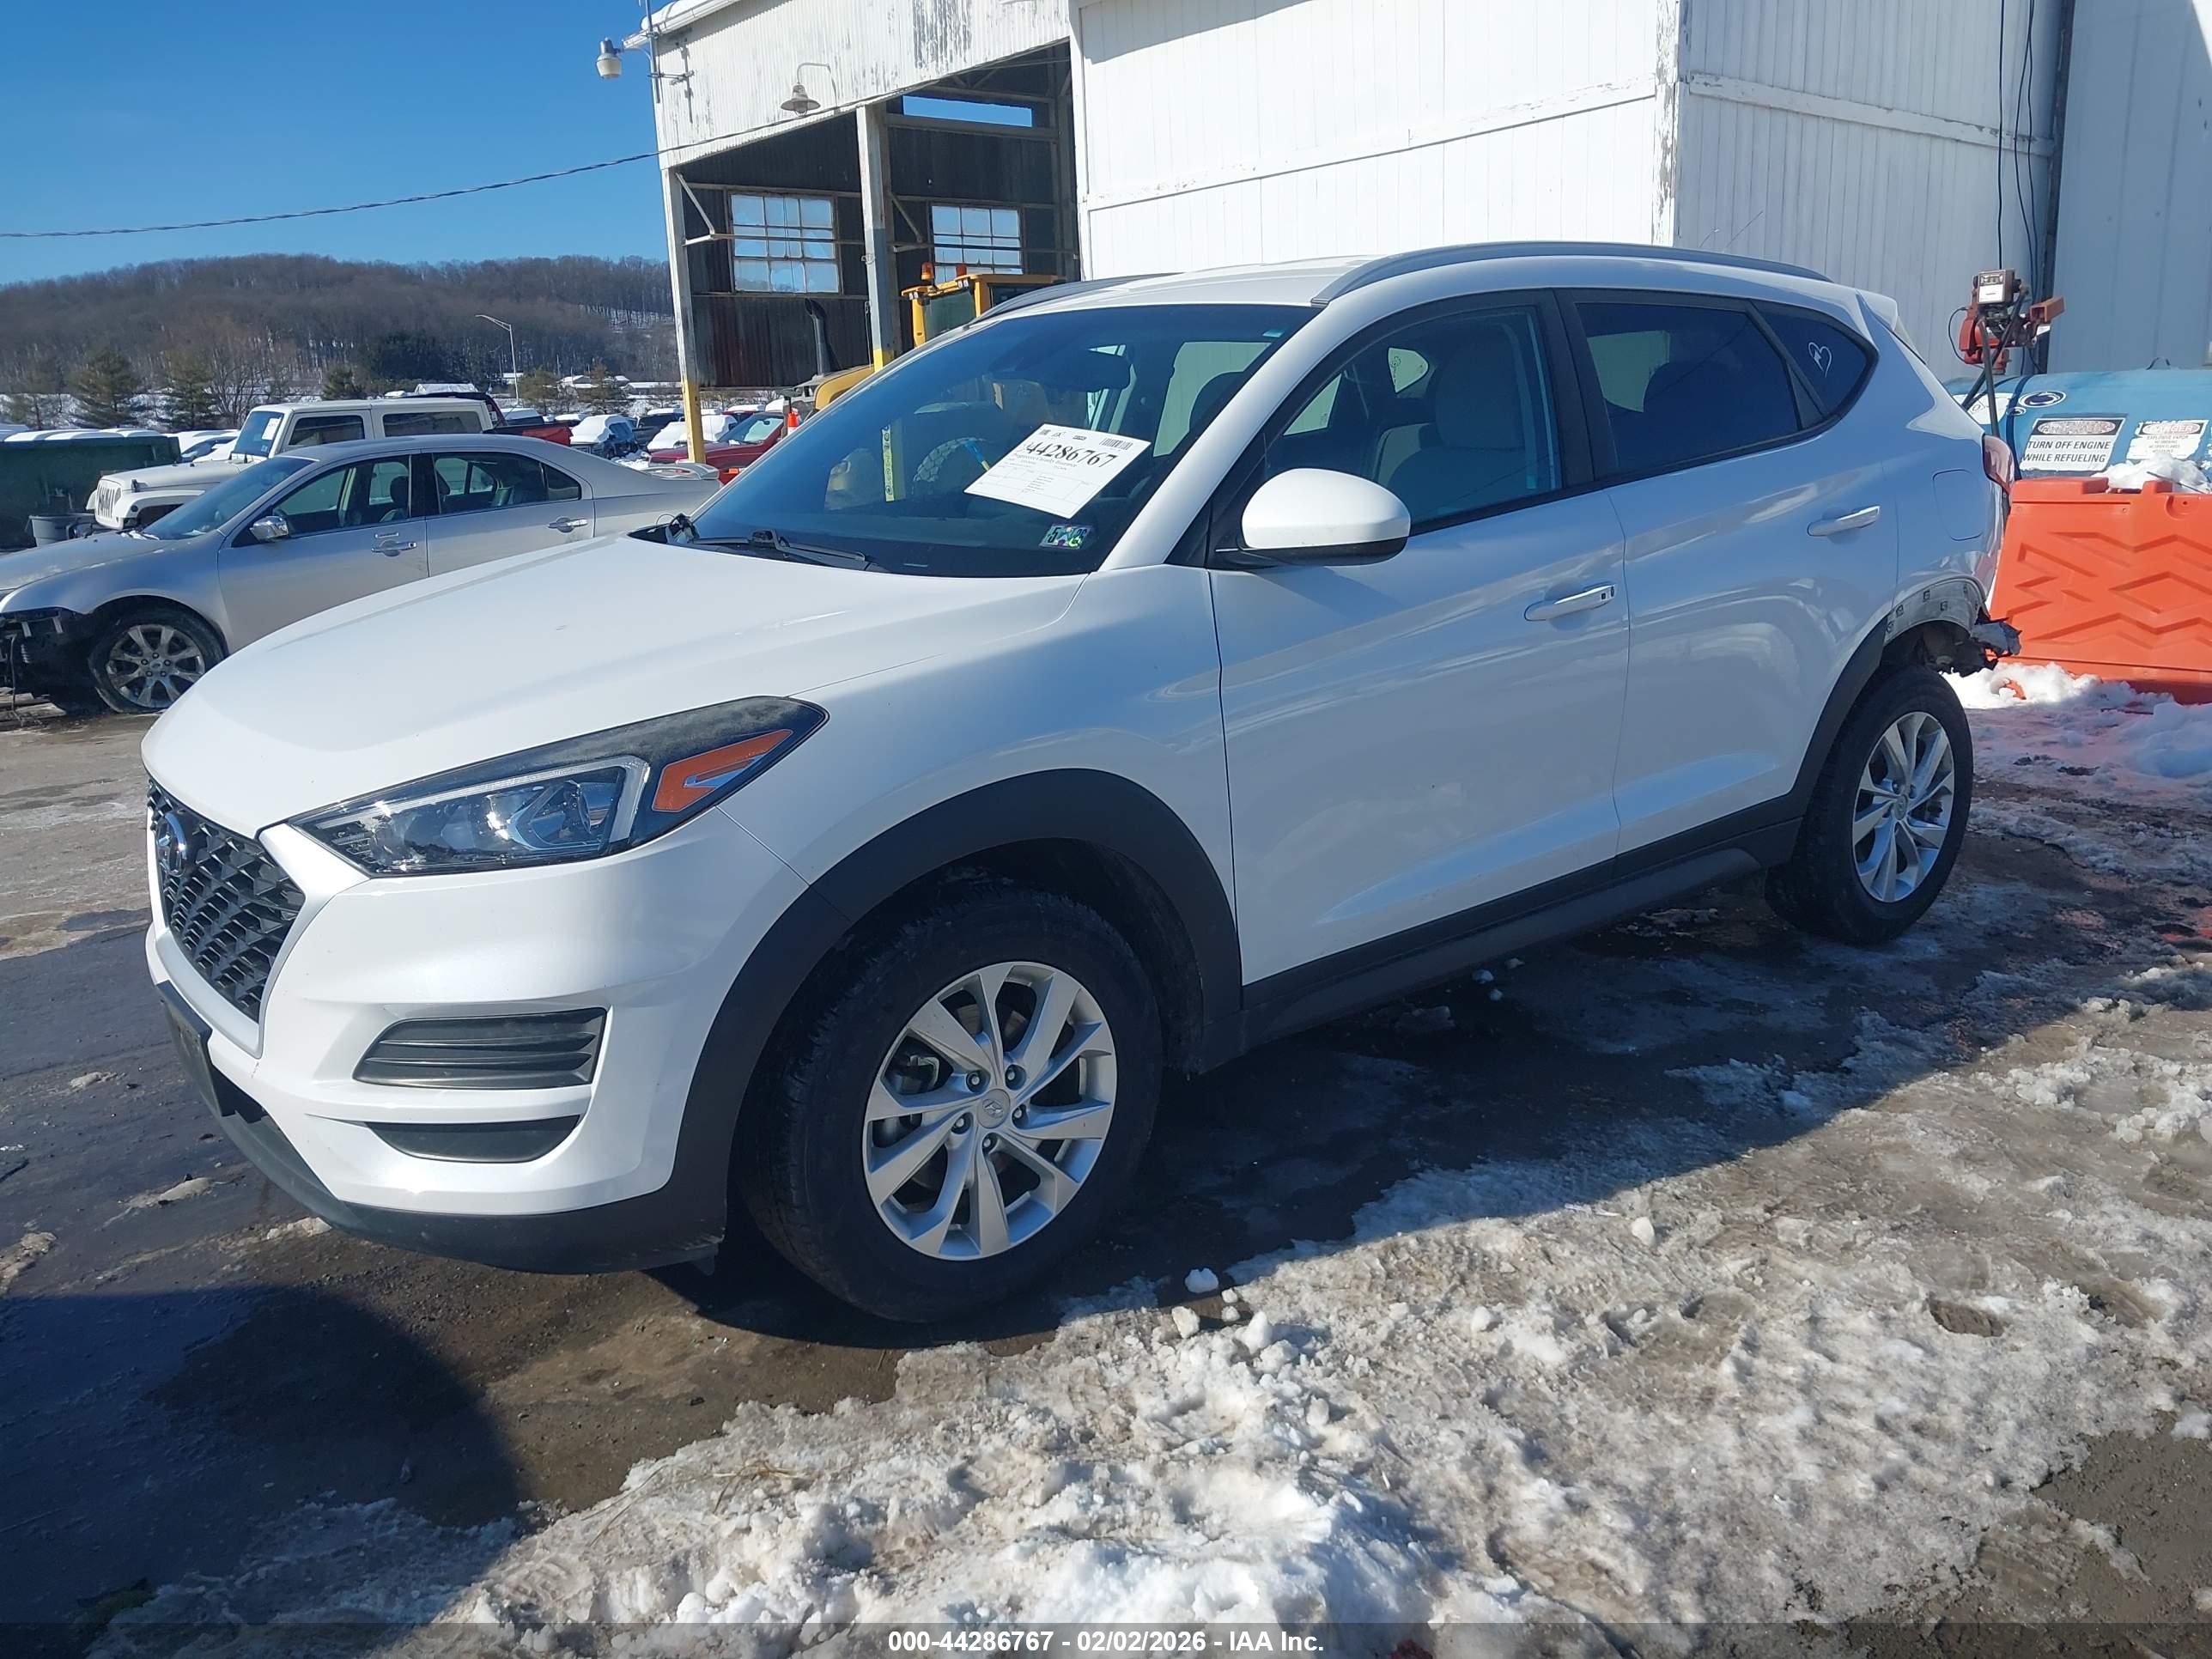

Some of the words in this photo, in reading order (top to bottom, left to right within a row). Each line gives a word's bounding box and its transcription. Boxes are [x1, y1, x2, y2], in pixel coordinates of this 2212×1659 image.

[2027, 441, 2052, 449] TURN
[2055, 441, 2073, 449] OFF
[2073, 441, 2112, 449] ENGINE
[1026, 441, 1119, 468] 44286767
[2022, 453, 2052, 462] WHILE
[2054, 453, 2106, 463] REFUELING
